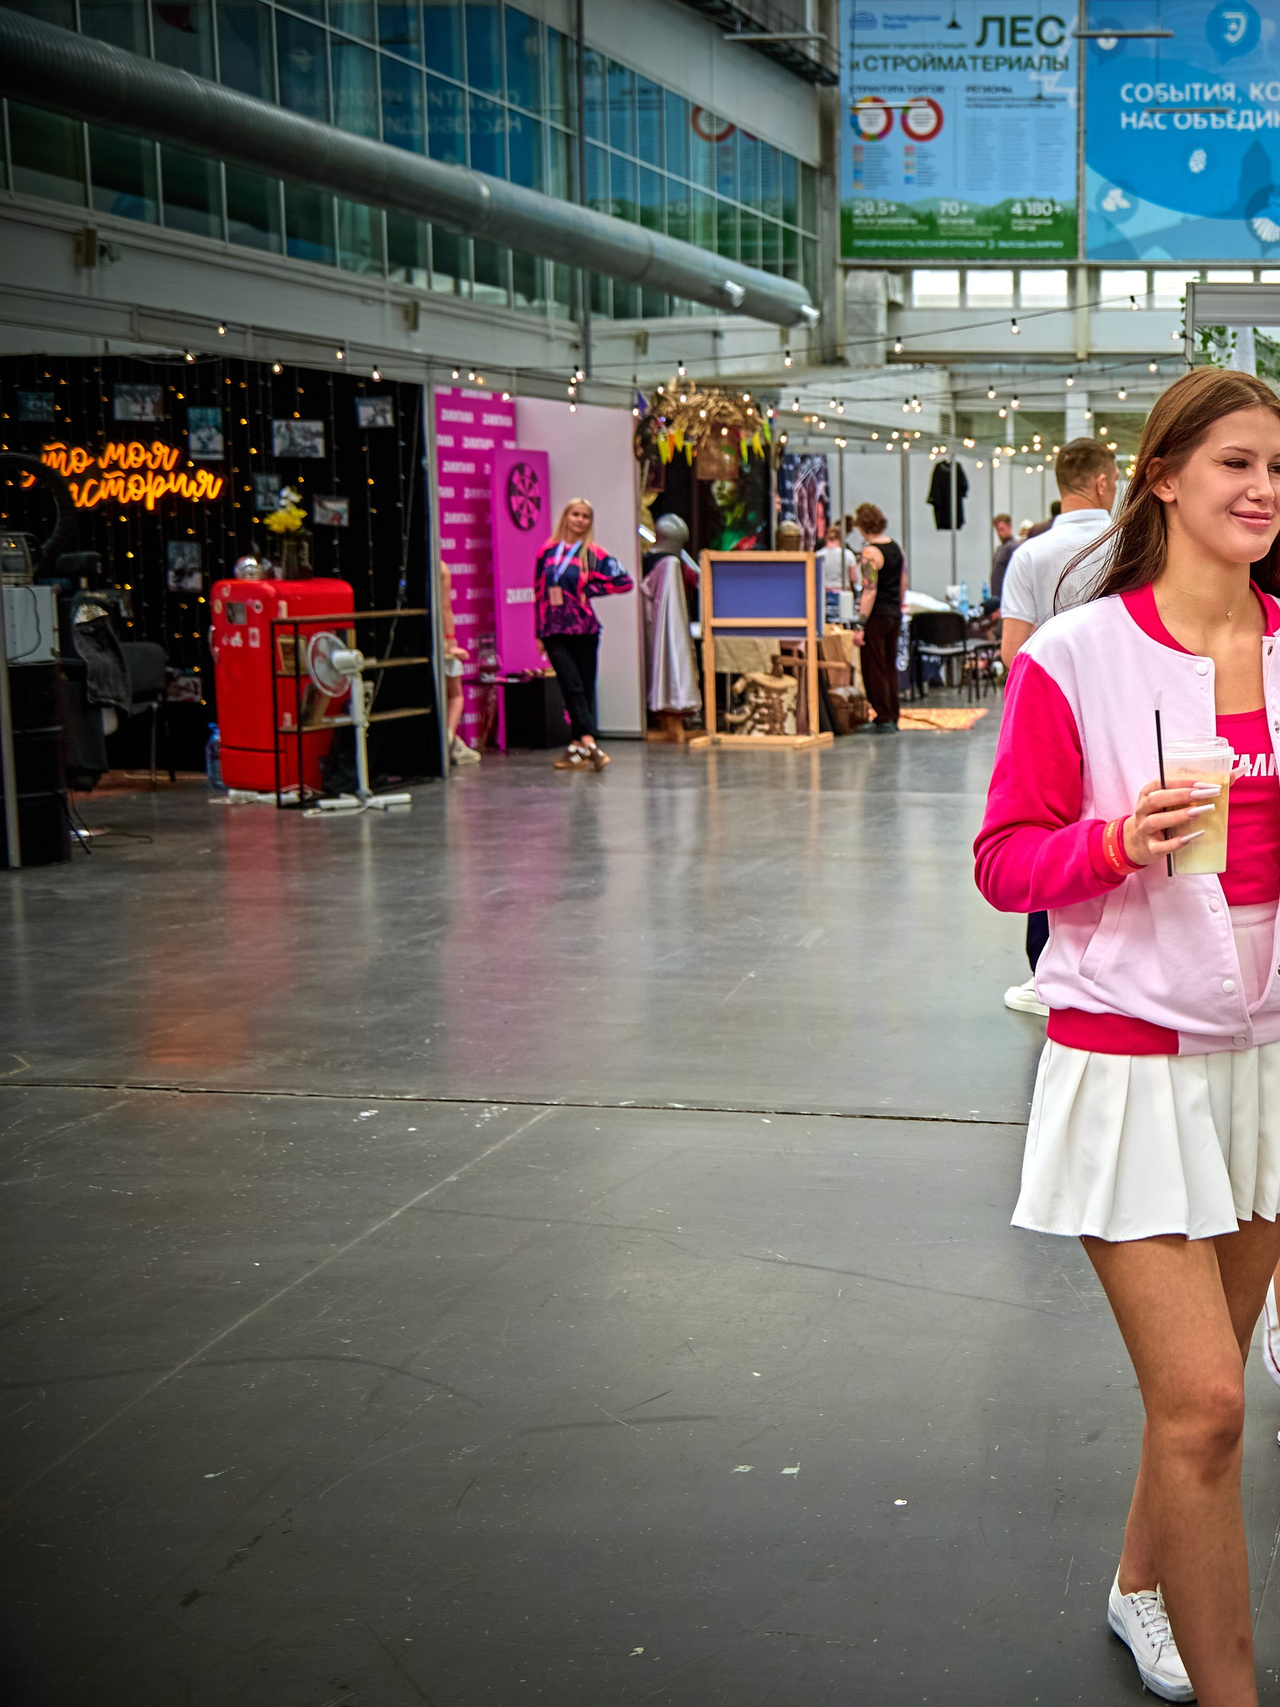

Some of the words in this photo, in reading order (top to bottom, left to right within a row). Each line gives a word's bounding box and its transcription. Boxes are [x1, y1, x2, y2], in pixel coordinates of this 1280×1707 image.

[975, 15, 1066, 48] ЛЕС
[863, 52, 1069, 72] СТРОЙМАТЕРИАЛЫ
[1121, 82, 1242, 104] СОБЫТИЯ,
[1121, 111, 1167, 130] НАС
[98, 441, 180, 471] моя
